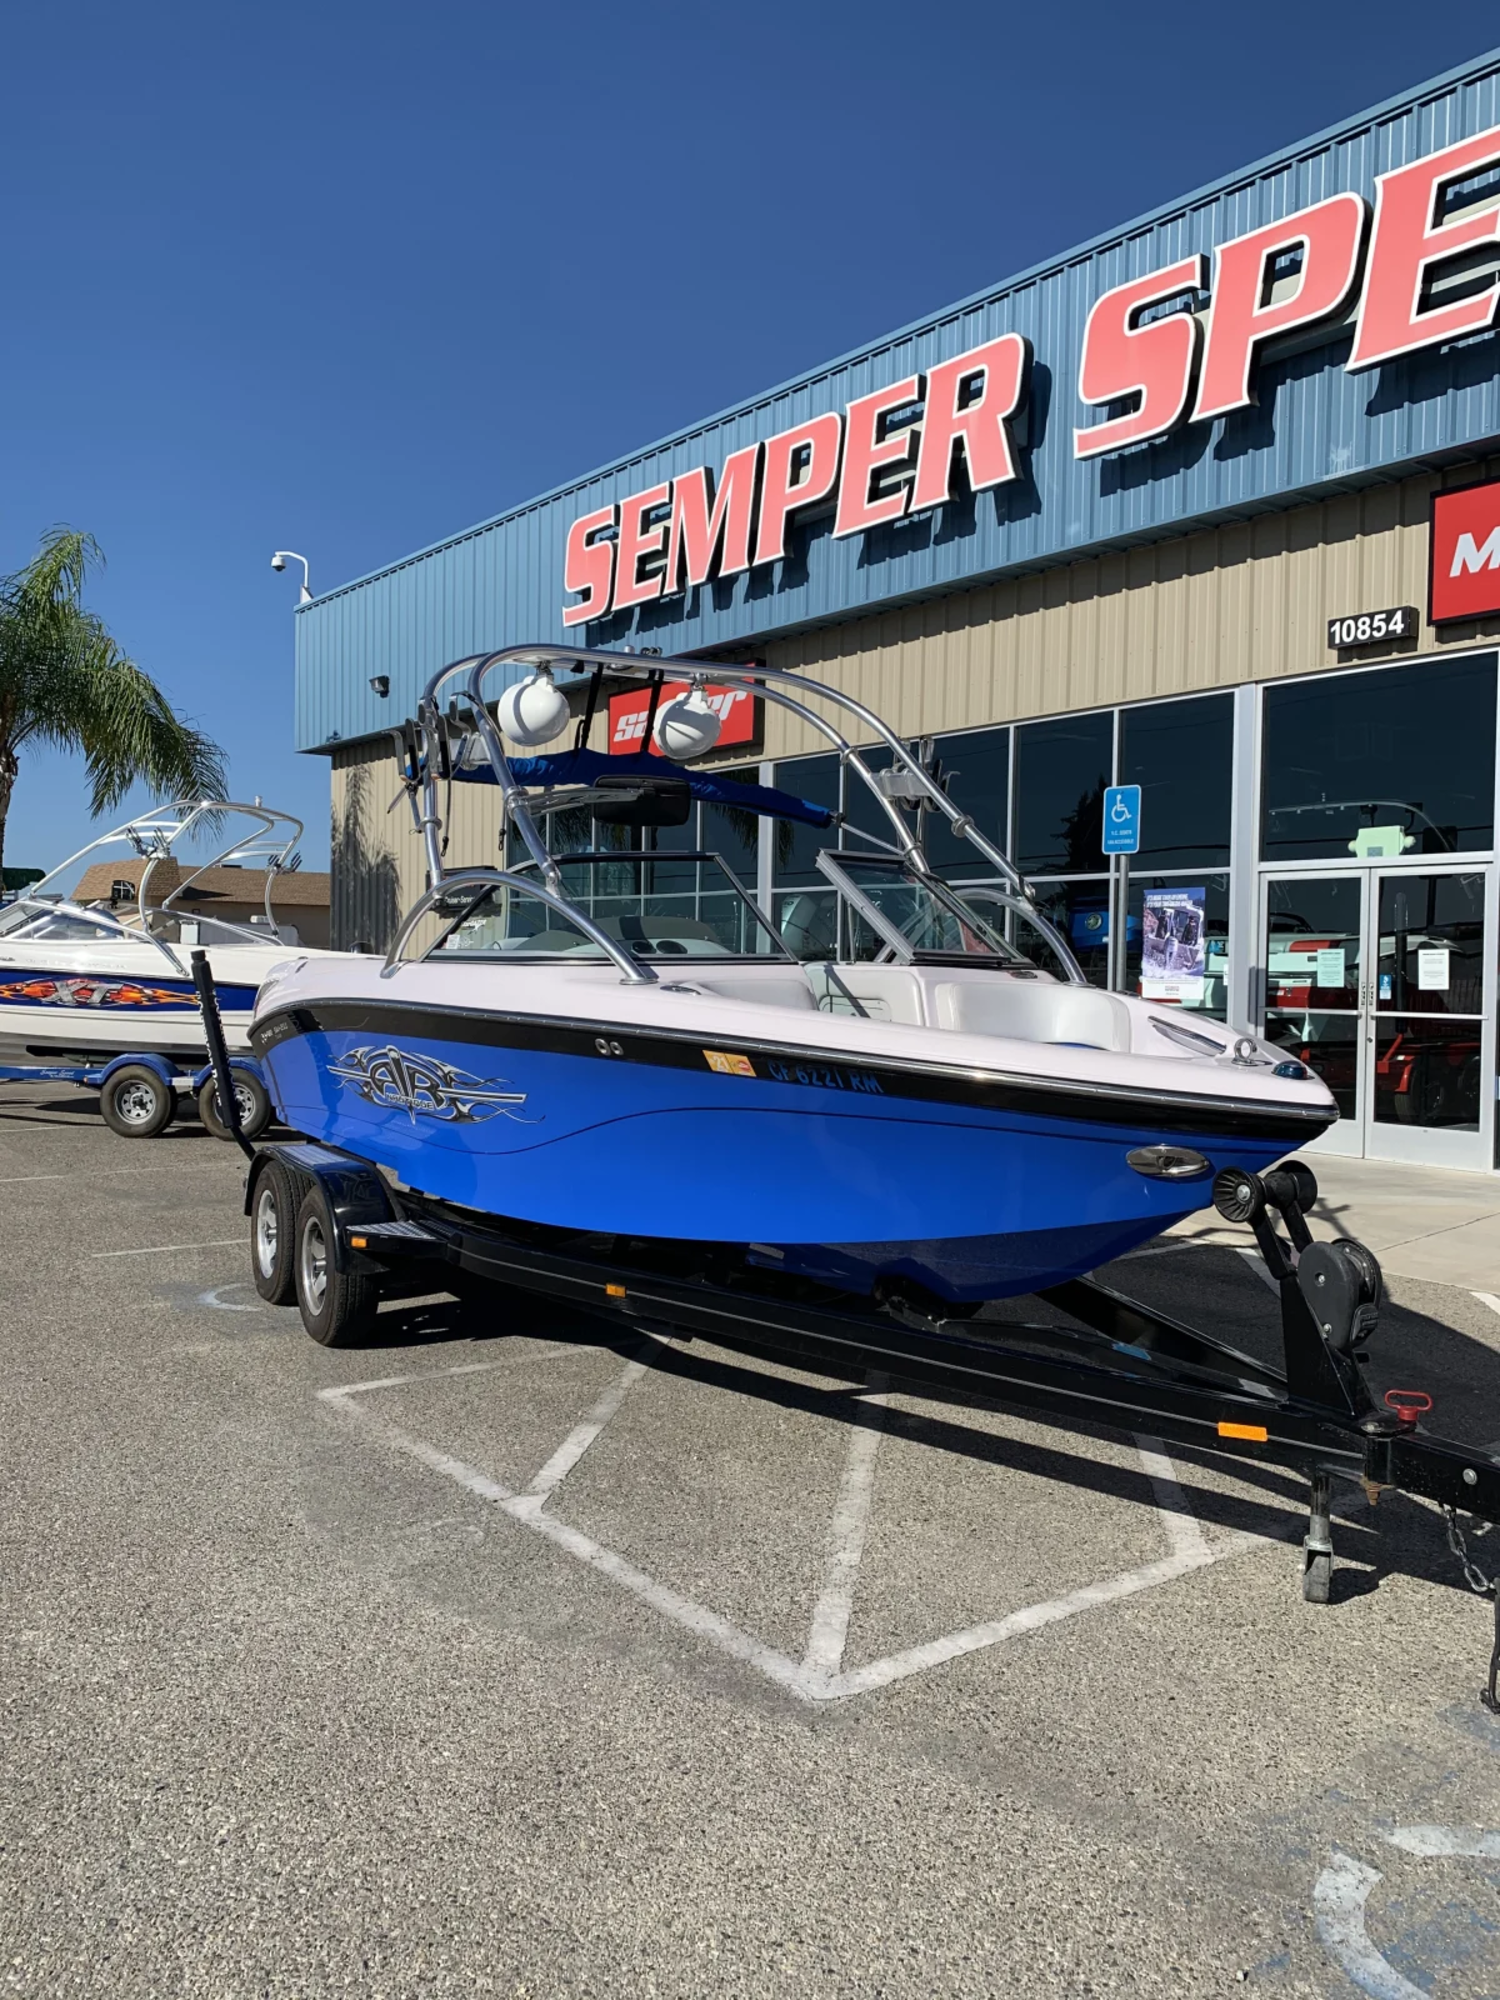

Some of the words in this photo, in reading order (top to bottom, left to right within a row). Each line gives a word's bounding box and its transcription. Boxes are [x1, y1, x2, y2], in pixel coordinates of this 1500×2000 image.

[562, 332, 1026, 628] SEMPER
[1330, 609, 1405, 645] 10854
[767, 1059, 790, 1081] CF
[796, 1064, 844, 1088] 6221
